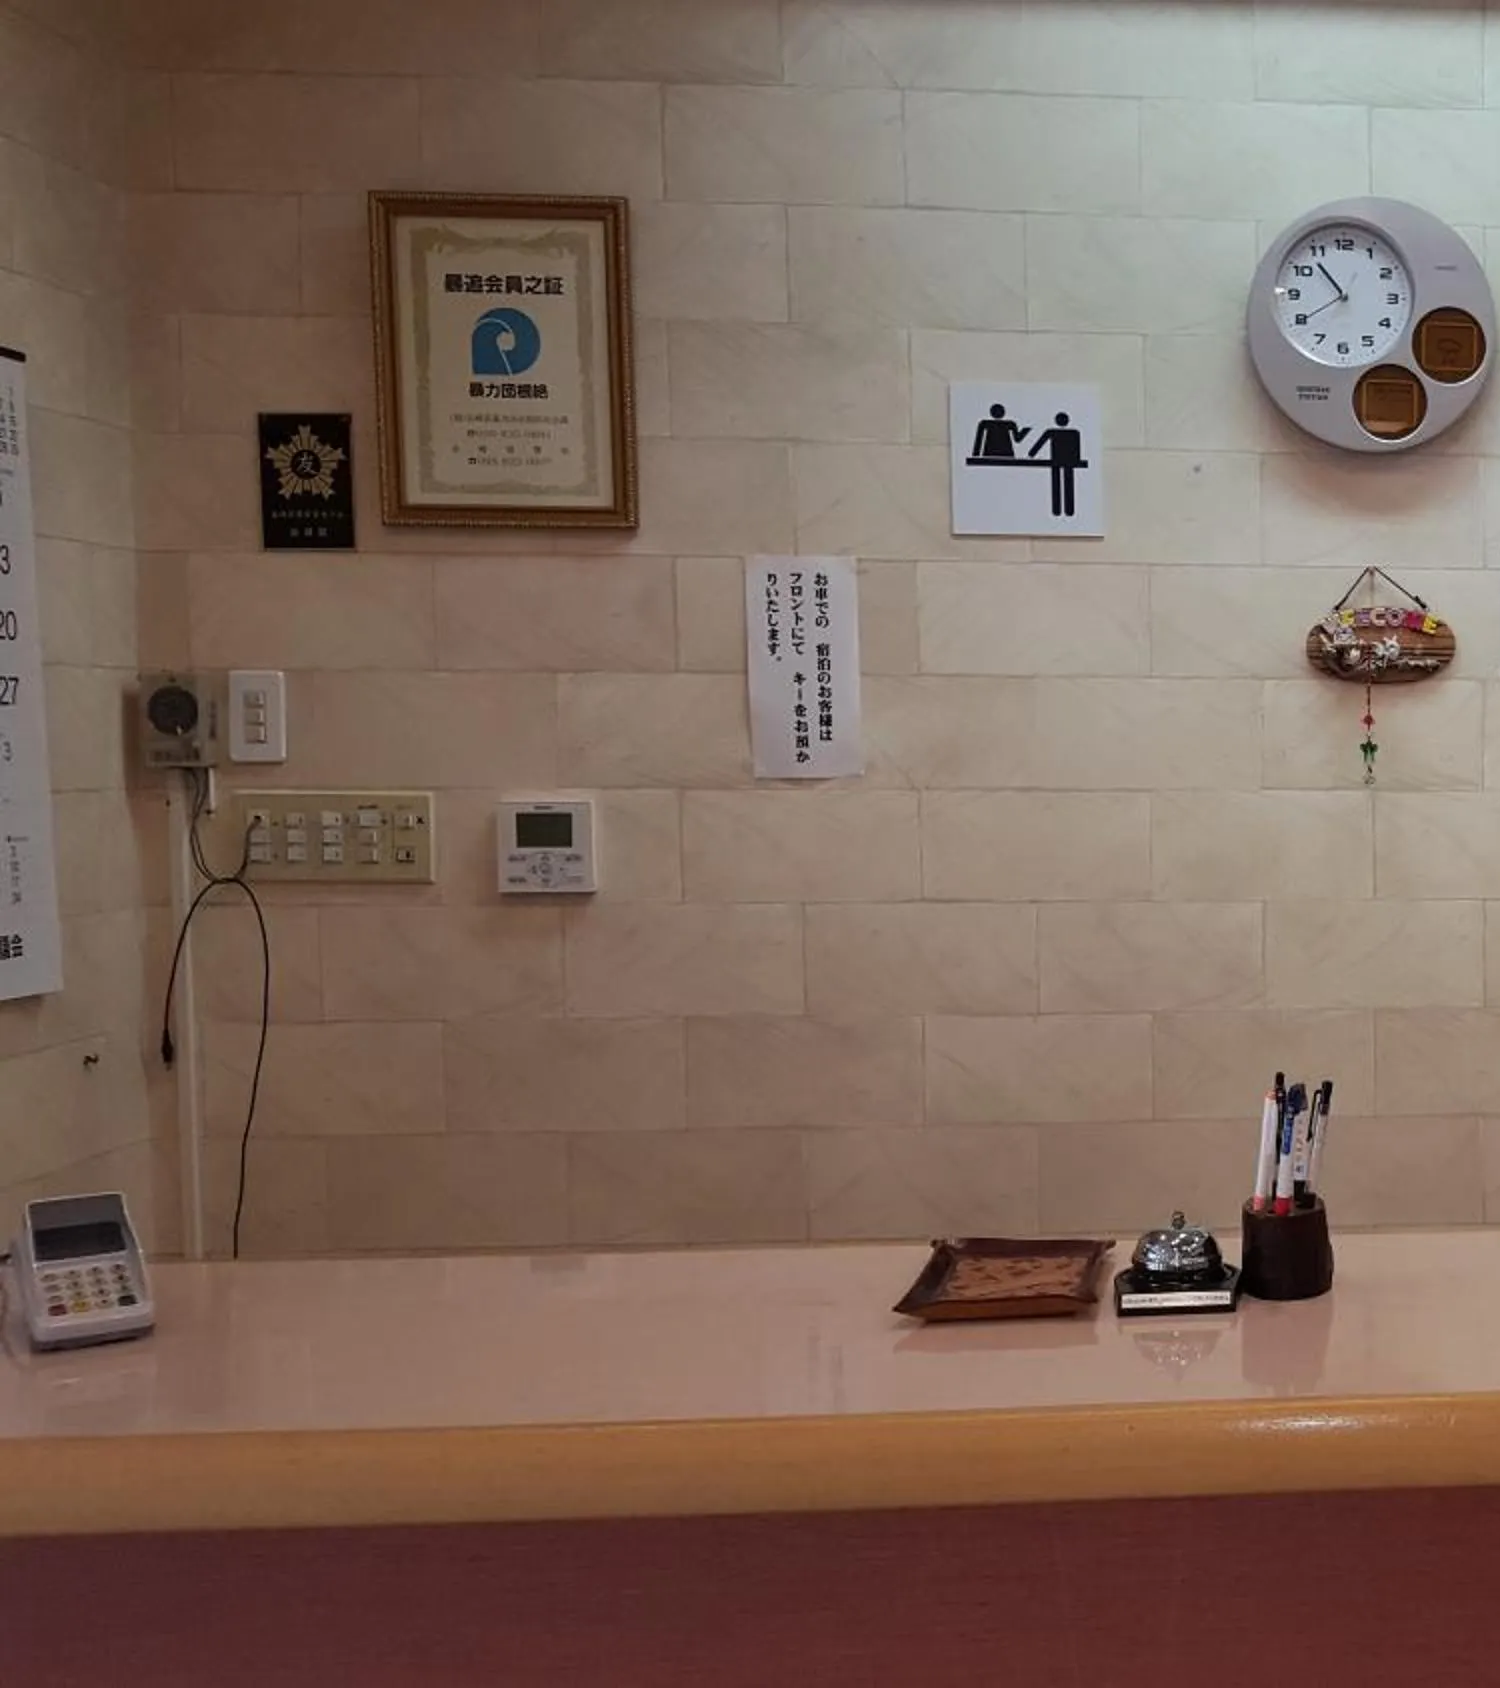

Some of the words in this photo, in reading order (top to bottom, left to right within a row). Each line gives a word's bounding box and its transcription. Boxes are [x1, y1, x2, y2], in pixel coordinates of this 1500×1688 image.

[1310, 245, 1326, 257] 11
[1334, 239, 1355, 252] 12
[1366, 247, 1373, 260] 1
[1293, 265, 1313, 277] 10
[1379, 267, 1393, 280] 2
[444, 272, 565, 297] 暴追会員之証
[1287, 288, 1301, 301] 9
[1386, 293, 1399, 305] 3
[1295, 313, 1307, 325] 8
[1378, 317, 1391, 329] 4
[1313, 333, 1327, 345] 7
[1361, 335, 1375, 347] 5
[1337, 342, 1349, 354] 6
[468, 382, 549, 400] 暴力団根絶
[295, 452, 320, 477] 友
[813, 571, 831, 629] お車での
[764, 572, 783, 663] りいたします。
[788, 572, 805, 656] フロントにて
[0, 675, 20, 705] 27
[816, 642, 833, 742] 宿泊のお客様は
[792, 671, 811, 764] キーをお預か
